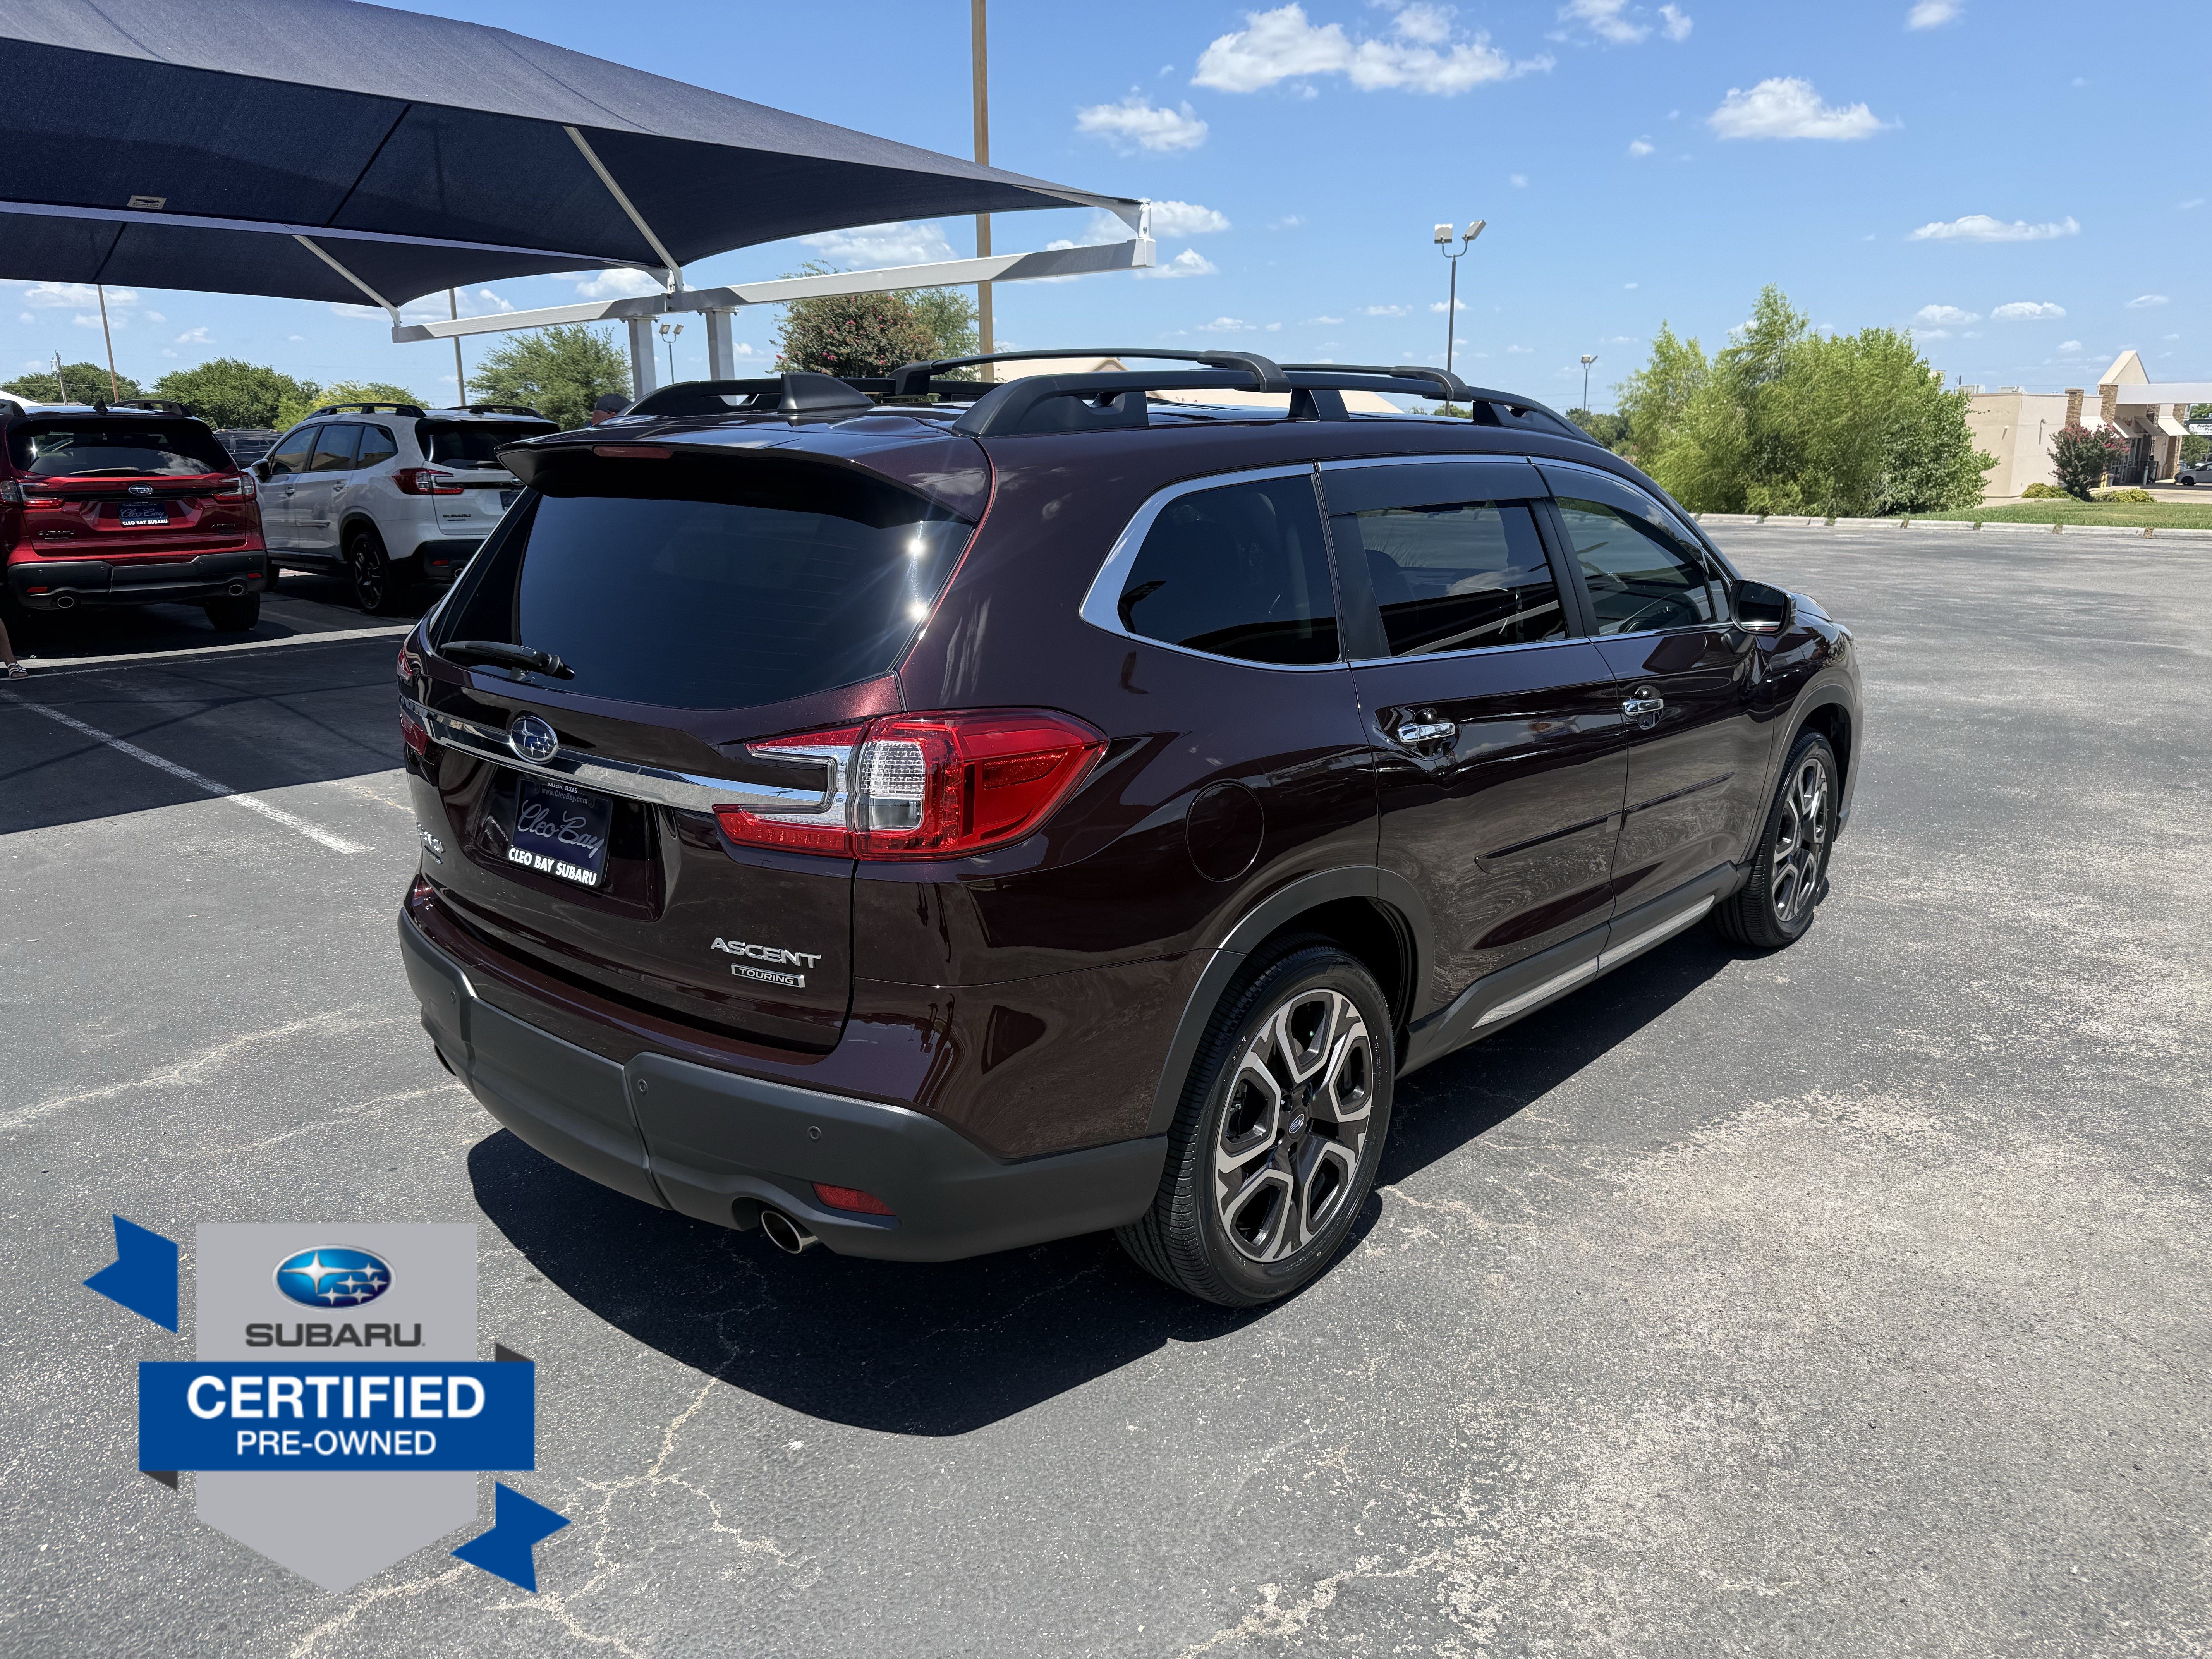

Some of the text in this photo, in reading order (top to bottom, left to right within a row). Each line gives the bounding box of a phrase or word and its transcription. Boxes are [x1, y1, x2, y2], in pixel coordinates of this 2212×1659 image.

[542, 788, 588, 804] www.CleoBay.com
[565, 785, 577, 793] TEXAS
[518, 800, 604, 858] Cleo Bay
[509, 848, 597, 886] CLEO BAY SUBARU
[710, 938, 821, 968] ASCENT
[739, 968, 794, 984] TOURING
